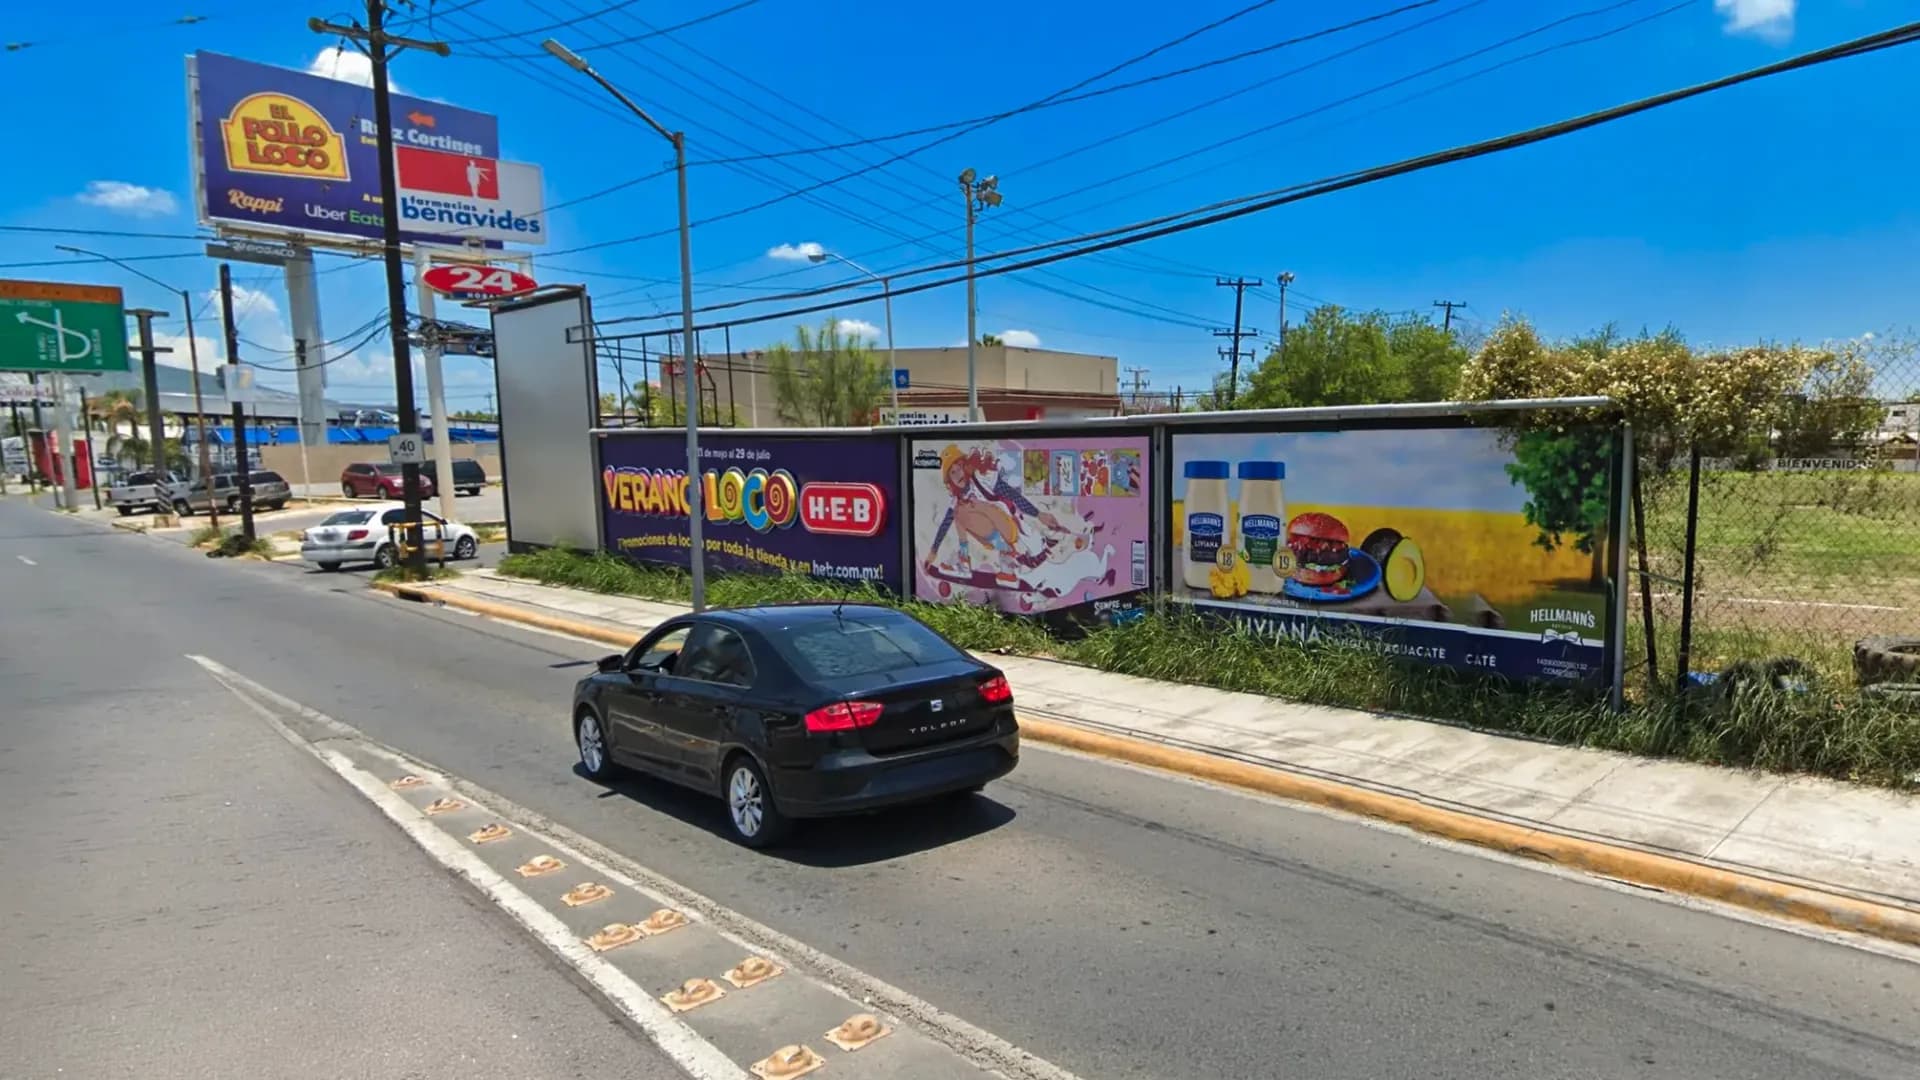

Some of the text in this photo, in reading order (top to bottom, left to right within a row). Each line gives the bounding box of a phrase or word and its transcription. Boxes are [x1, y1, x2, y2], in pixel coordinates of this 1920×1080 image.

[269, 103, 295, 121] EL
[241, 116, 328, 147] POLLO
[246, 141, 330, 170] LOCO
[227, 188, 285, 214] Rappi
[409, 195, 478, 212] farmacias
[304, 203, 347, 222] Uber
[401, 197, 541, 234] benavides
[449, 266, 518, 292] 24
[399, 440, 416, 452] 40
[735, 447, 745, 459] 29
[704, 469, 798, 530] LOCO
[667, 533, 678, 547] de
[706, 539, 721, 553] por
[723, 540, 744, 557] toda
[745, 543, 755, 560] la
[756, 548, 788, 570] tienda
[1222, 551, 1232, 566] 18
[1279, 555, 1290, 570] 19
[1530, 607, 1596, 629] HELLMANN'S
